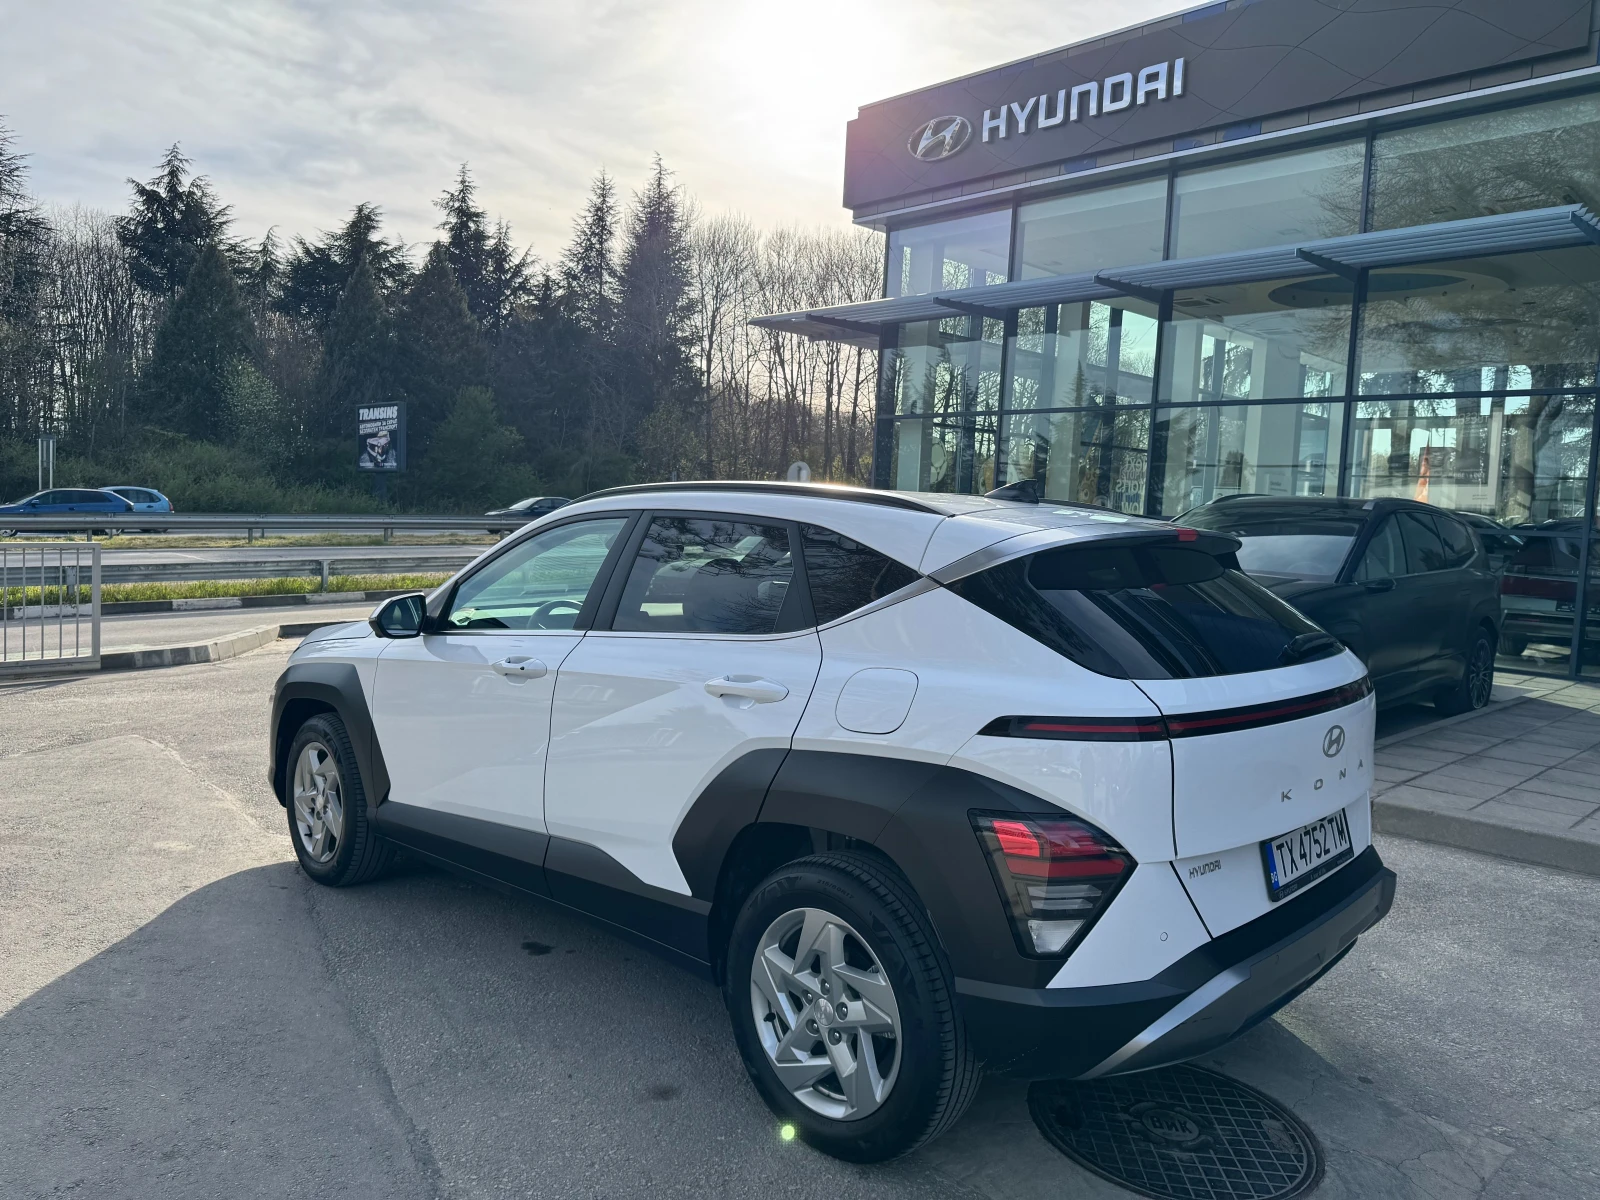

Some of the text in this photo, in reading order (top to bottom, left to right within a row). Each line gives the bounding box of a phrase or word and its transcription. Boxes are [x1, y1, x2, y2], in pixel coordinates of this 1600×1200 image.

[982, 57, 1185, 143] HYUNDAI
[359, 406, 398, 420] TRANSINS
[1281, 759, 1363, 802] KONA
[1189, 860, 1221, 879] HYUNDAI
